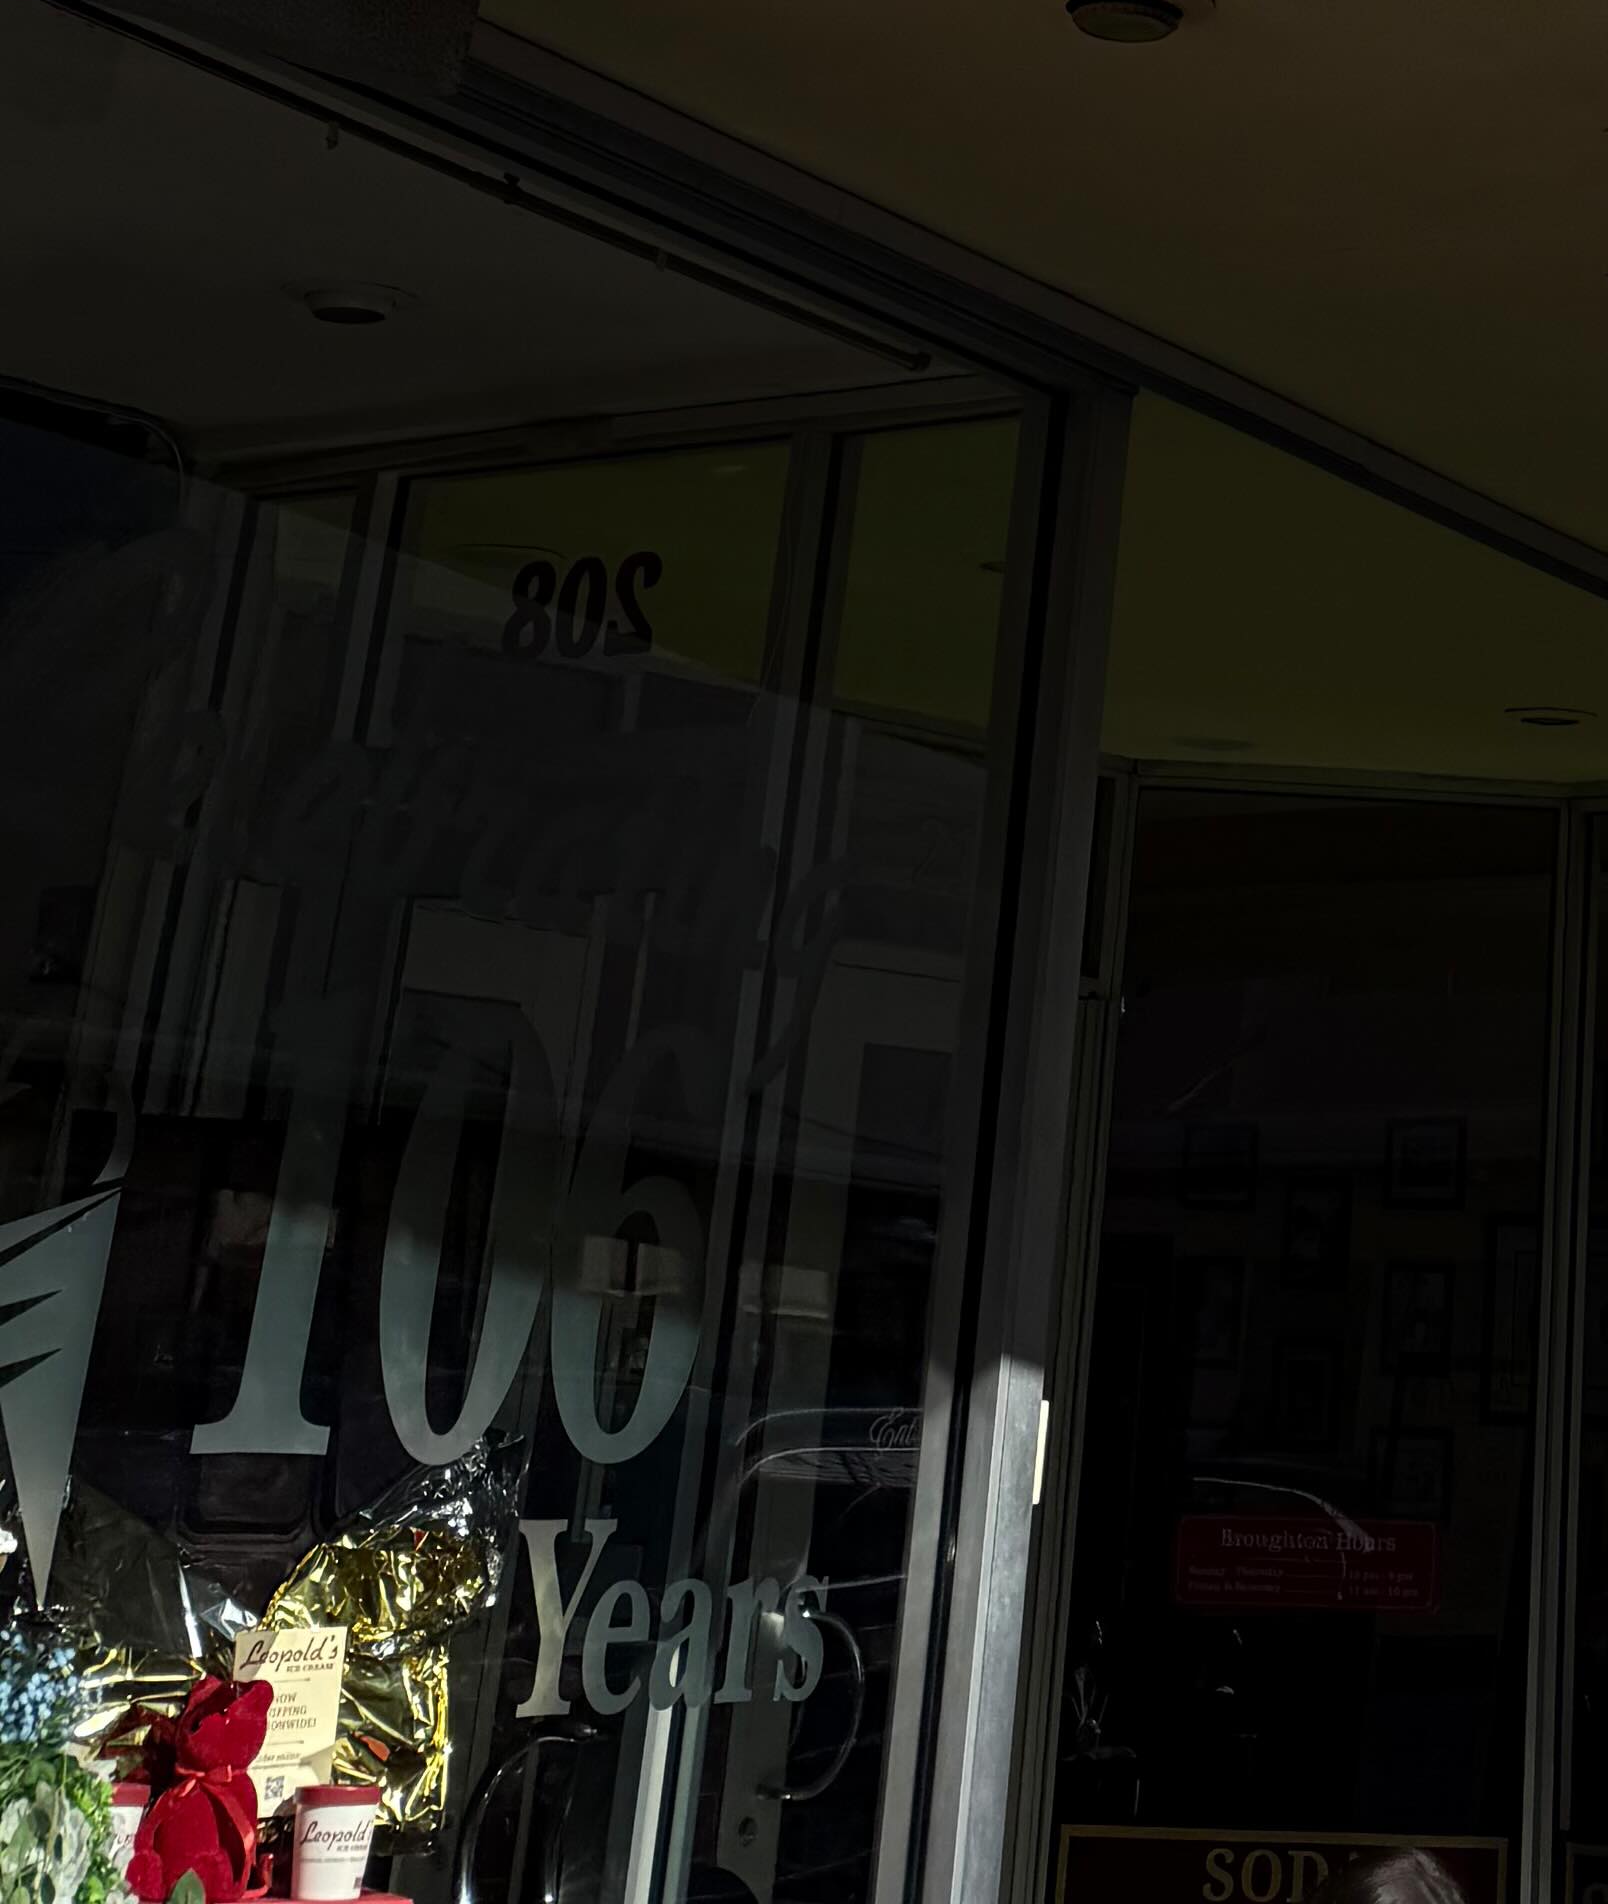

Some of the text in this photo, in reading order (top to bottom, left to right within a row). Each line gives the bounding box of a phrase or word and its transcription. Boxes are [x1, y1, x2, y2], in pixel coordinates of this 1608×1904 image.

[515, 1518, 829, 1718] Years
[239, 1634, 339, 1672] Leopold's
[1201, 1847, 1336, 1903] SOD
